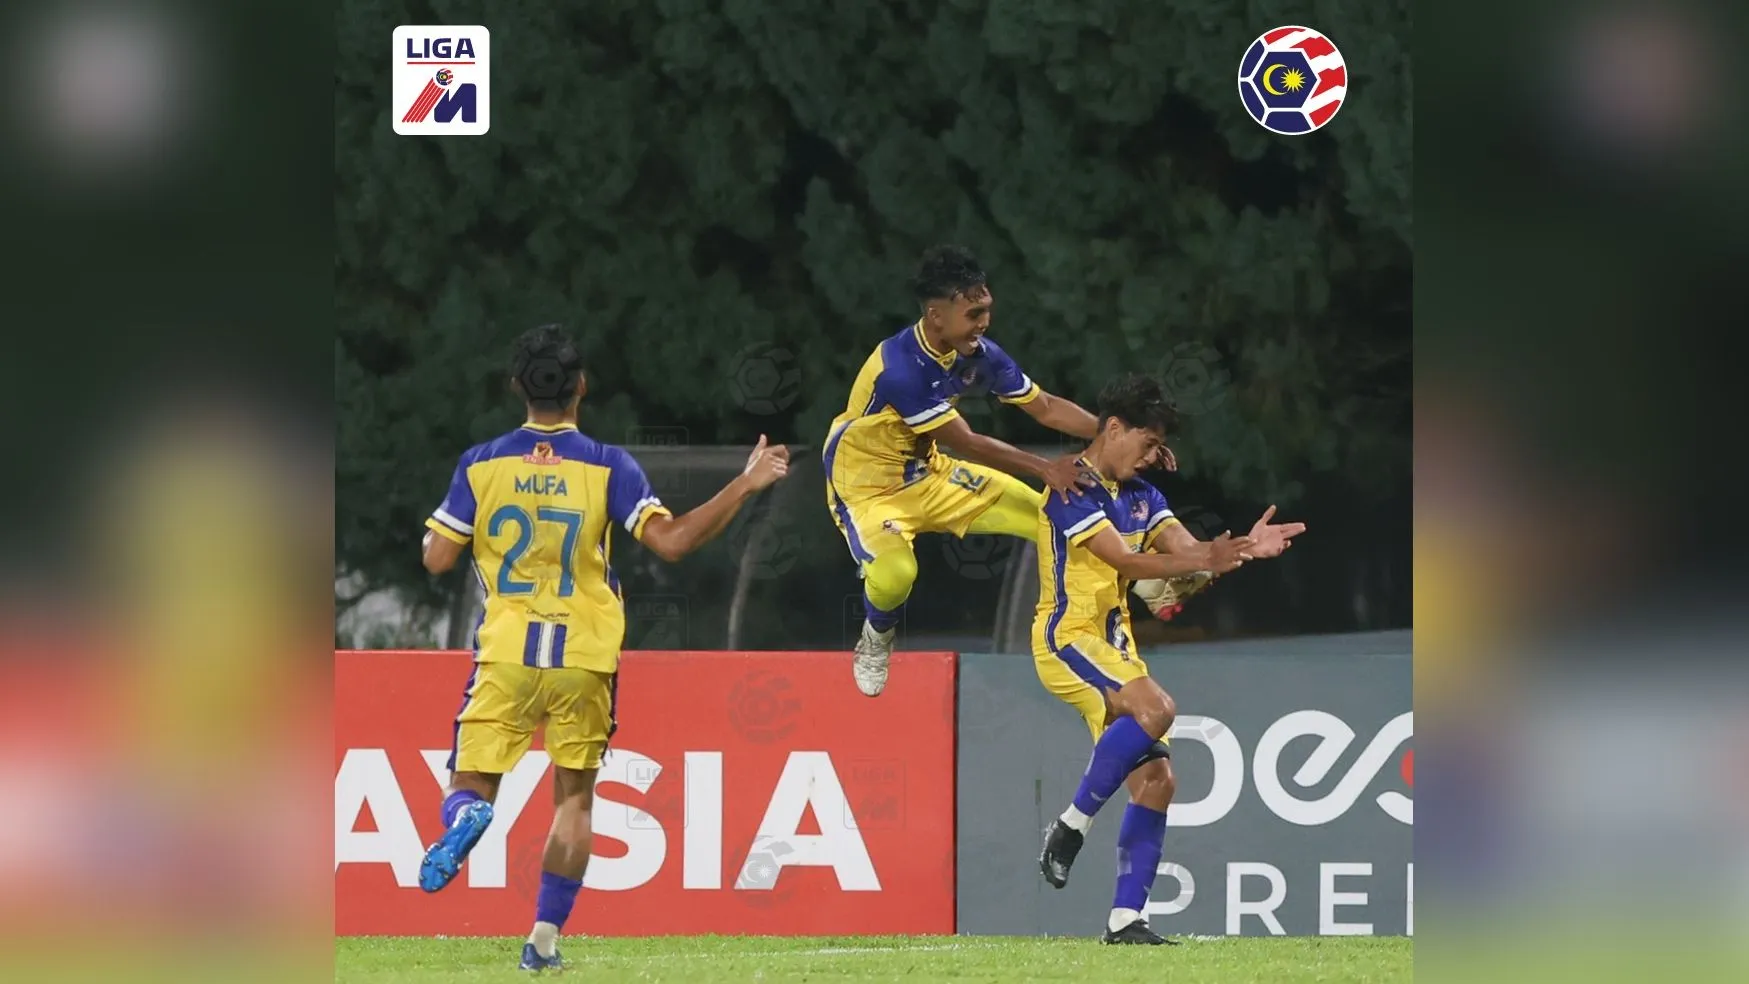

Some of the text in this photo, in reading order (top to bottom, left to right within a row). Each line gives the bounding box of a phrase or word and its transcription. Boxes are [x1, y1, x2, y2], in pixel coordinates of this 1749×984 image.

[514, 474, 567, 496] MUFA
[488, 504, 584, 597] 27
[1140, 862, 1413, 936] PRE
